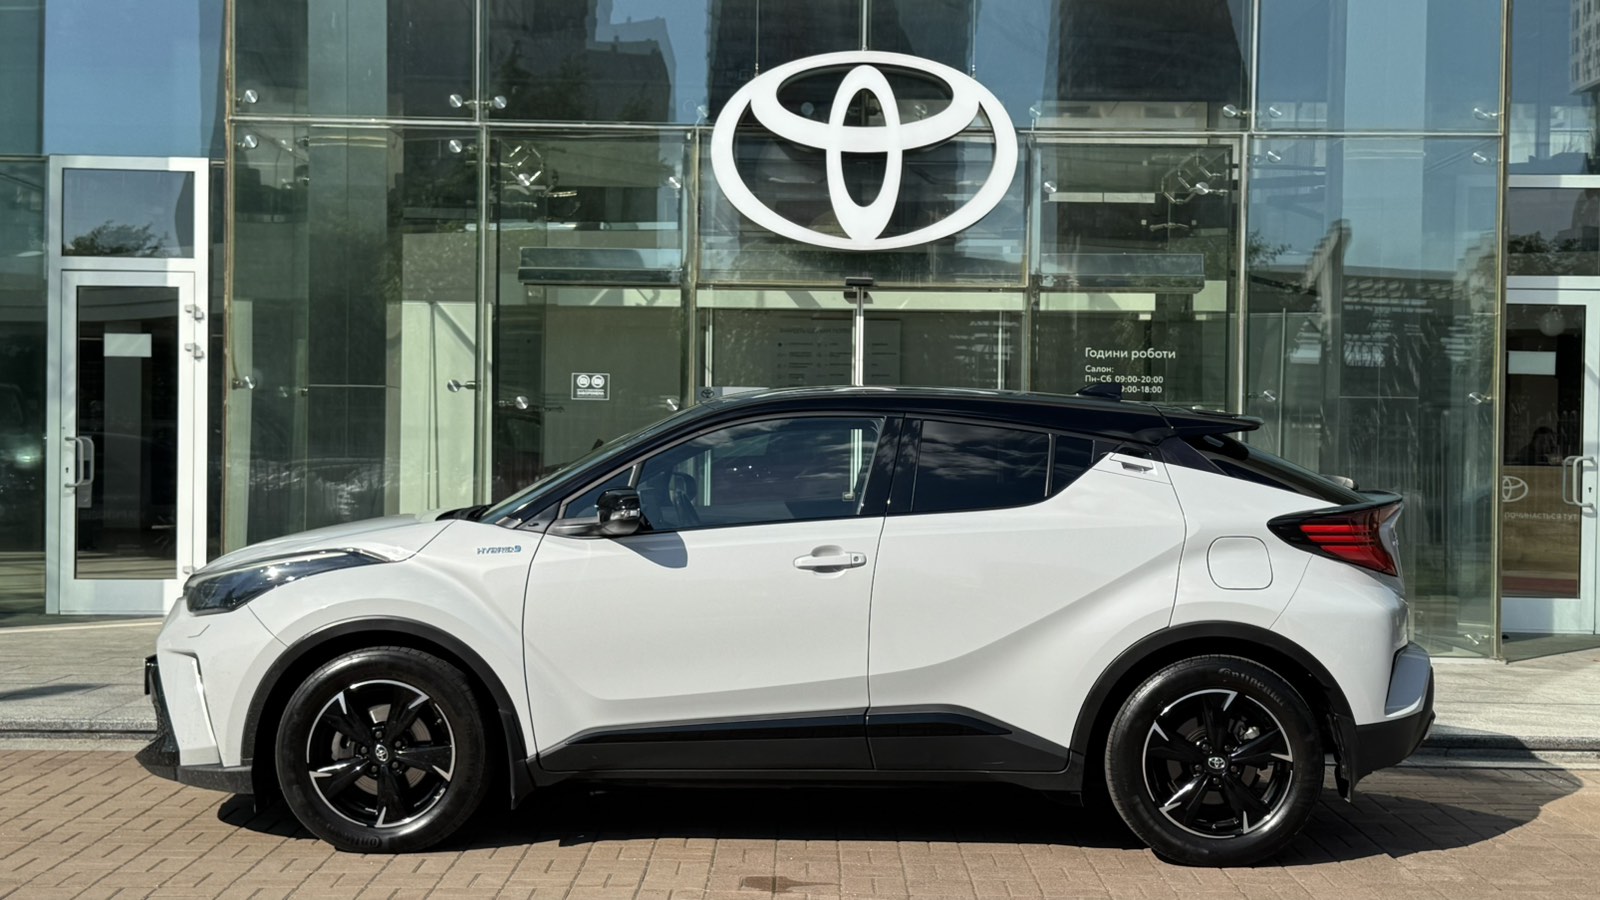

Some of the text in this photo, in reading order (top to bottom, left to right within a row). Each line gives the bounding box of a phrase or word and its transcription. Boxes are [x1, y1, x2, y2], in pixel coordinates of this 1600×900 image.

[1085, 347, 1176, 360] Години роботи
[1085, 365, 1114, 373] Салон:
[1115, 375, 1164, 383] 09:00-20:00
